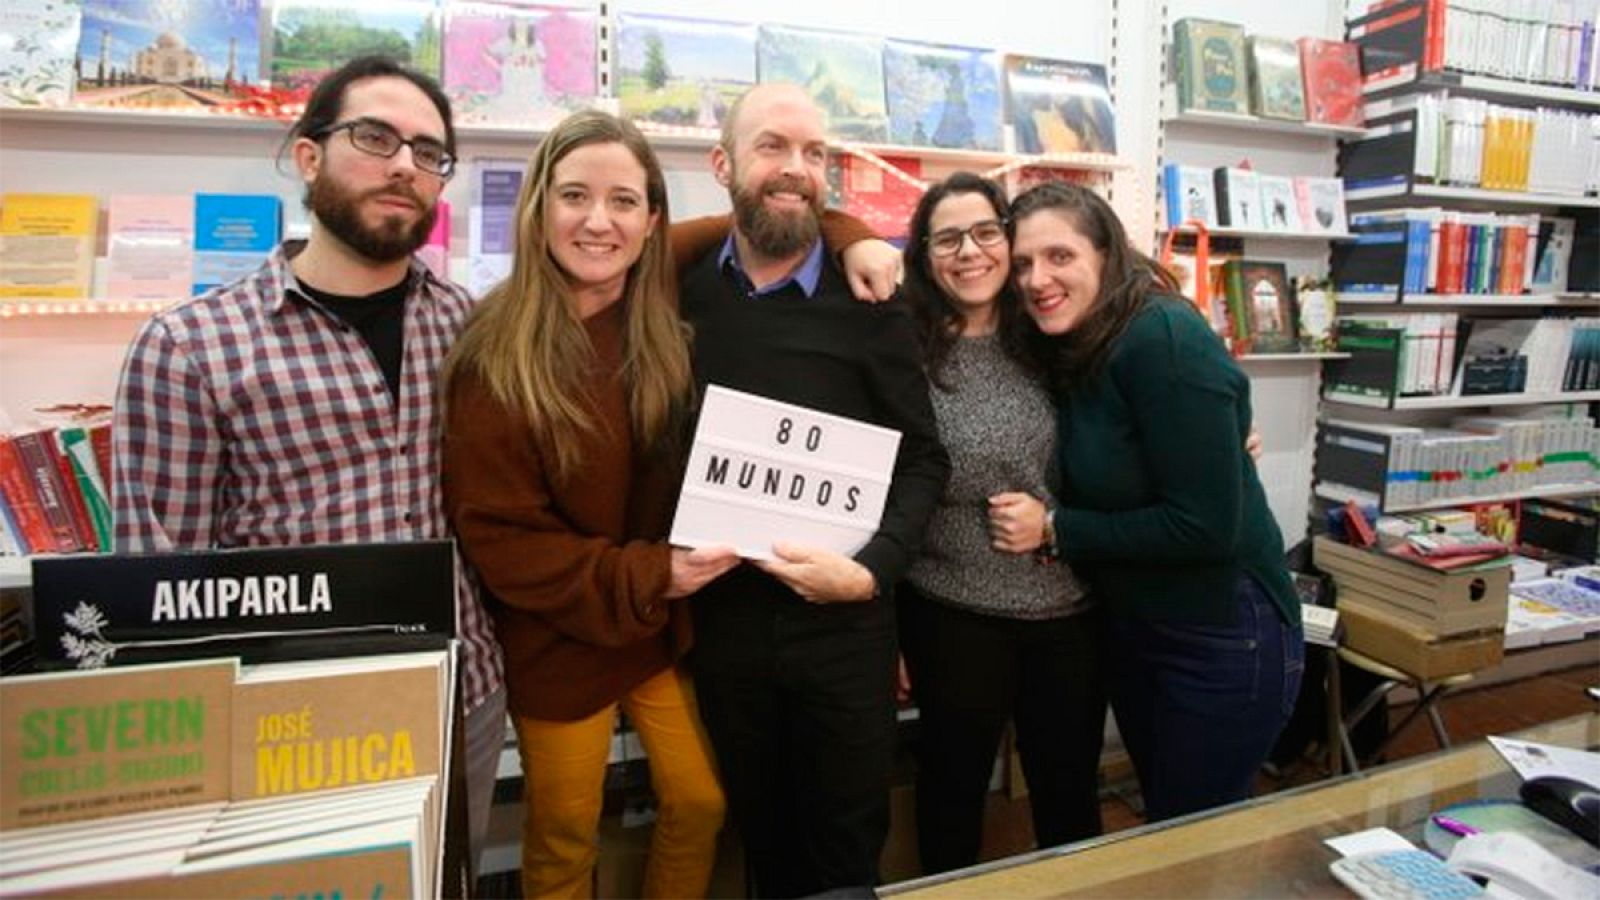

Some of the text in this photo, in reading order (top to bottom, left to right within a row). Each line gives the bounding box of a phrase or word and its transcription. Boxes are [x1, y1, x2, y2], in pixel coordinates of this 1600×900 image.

[776, 418, 822, 452] 80
[706, 455, 861, 512] MUNDOS
[151, 573, 333, 621] AKIPARLA
[20, 697, 206, 761] SEVERN
[256, 706, 313, 743] JOSÉ
[256, 730, 416, 796] MUJICA
